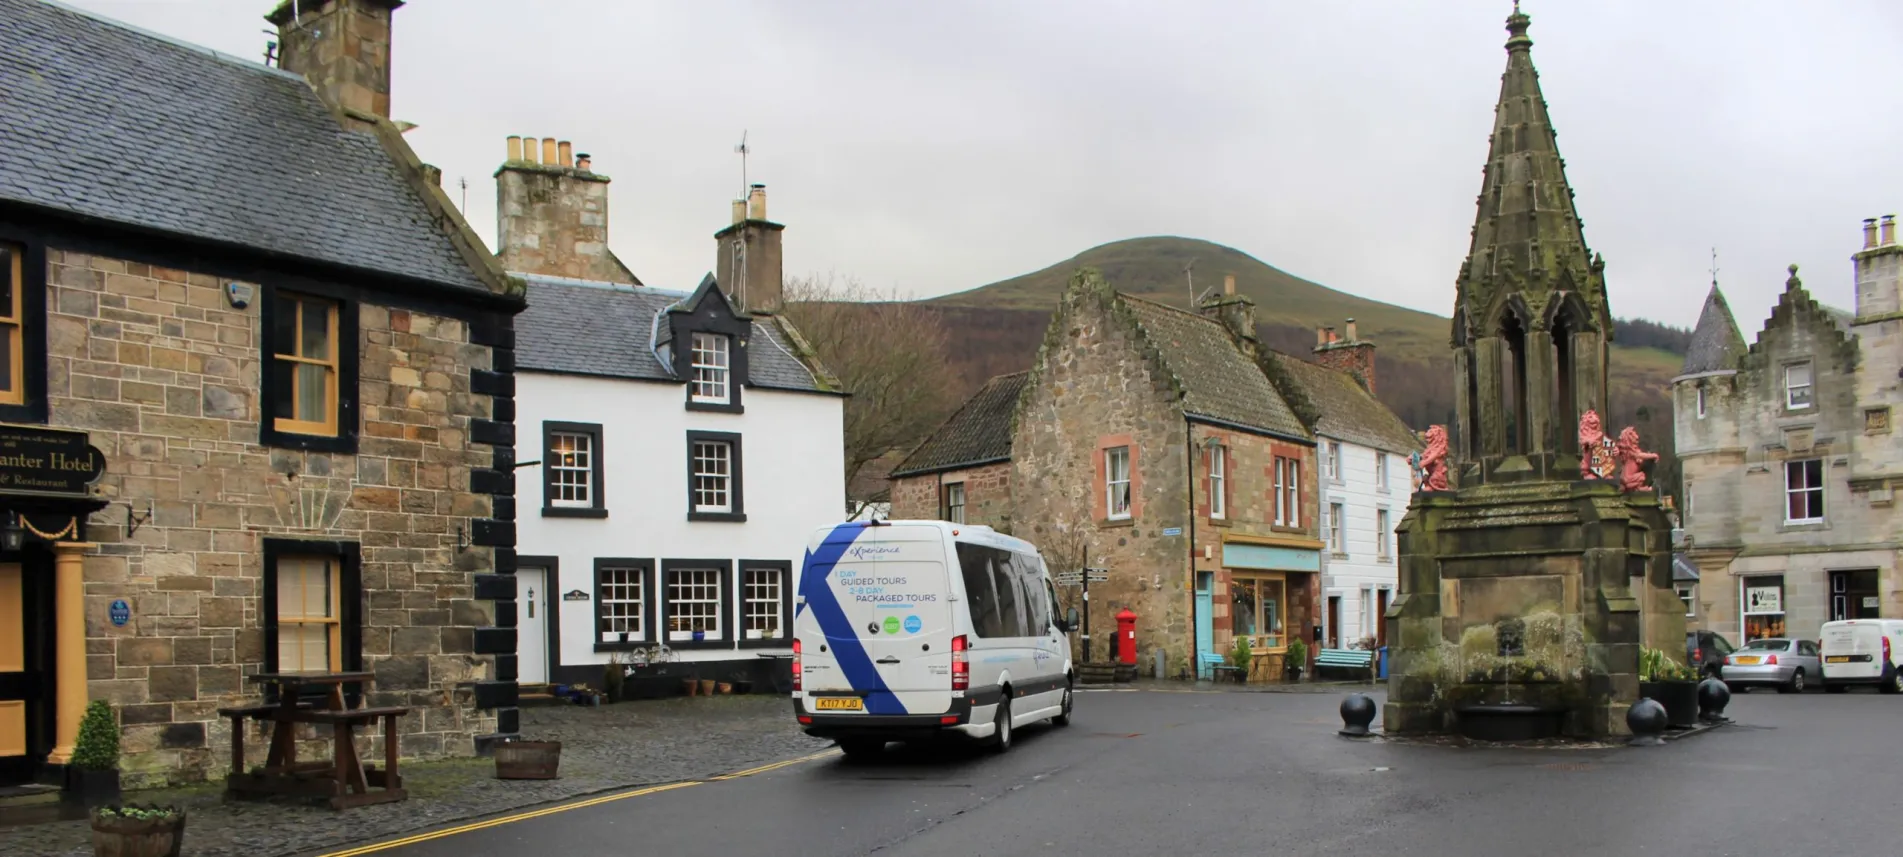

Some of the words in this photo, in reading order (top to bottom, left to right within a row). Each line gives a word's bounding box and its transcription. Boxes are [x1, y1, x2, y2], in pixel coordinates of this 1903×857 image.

[50, 452, 94, 472] Hotel
[14, 475, 68, 488] Restaurant
[840, 570, 857, 578] DAY
[841, 578, 874, 586] GUIDED
[876, 577, 907, 585] TOURS
[849, 587, 864, 595] 2-8
[866, 587, 883, 595] DAY
[856, 595, 904, 603] PACKAGED
[906, 594, 937, 602] TOURS
[821, 699, 840, 708] KT17
